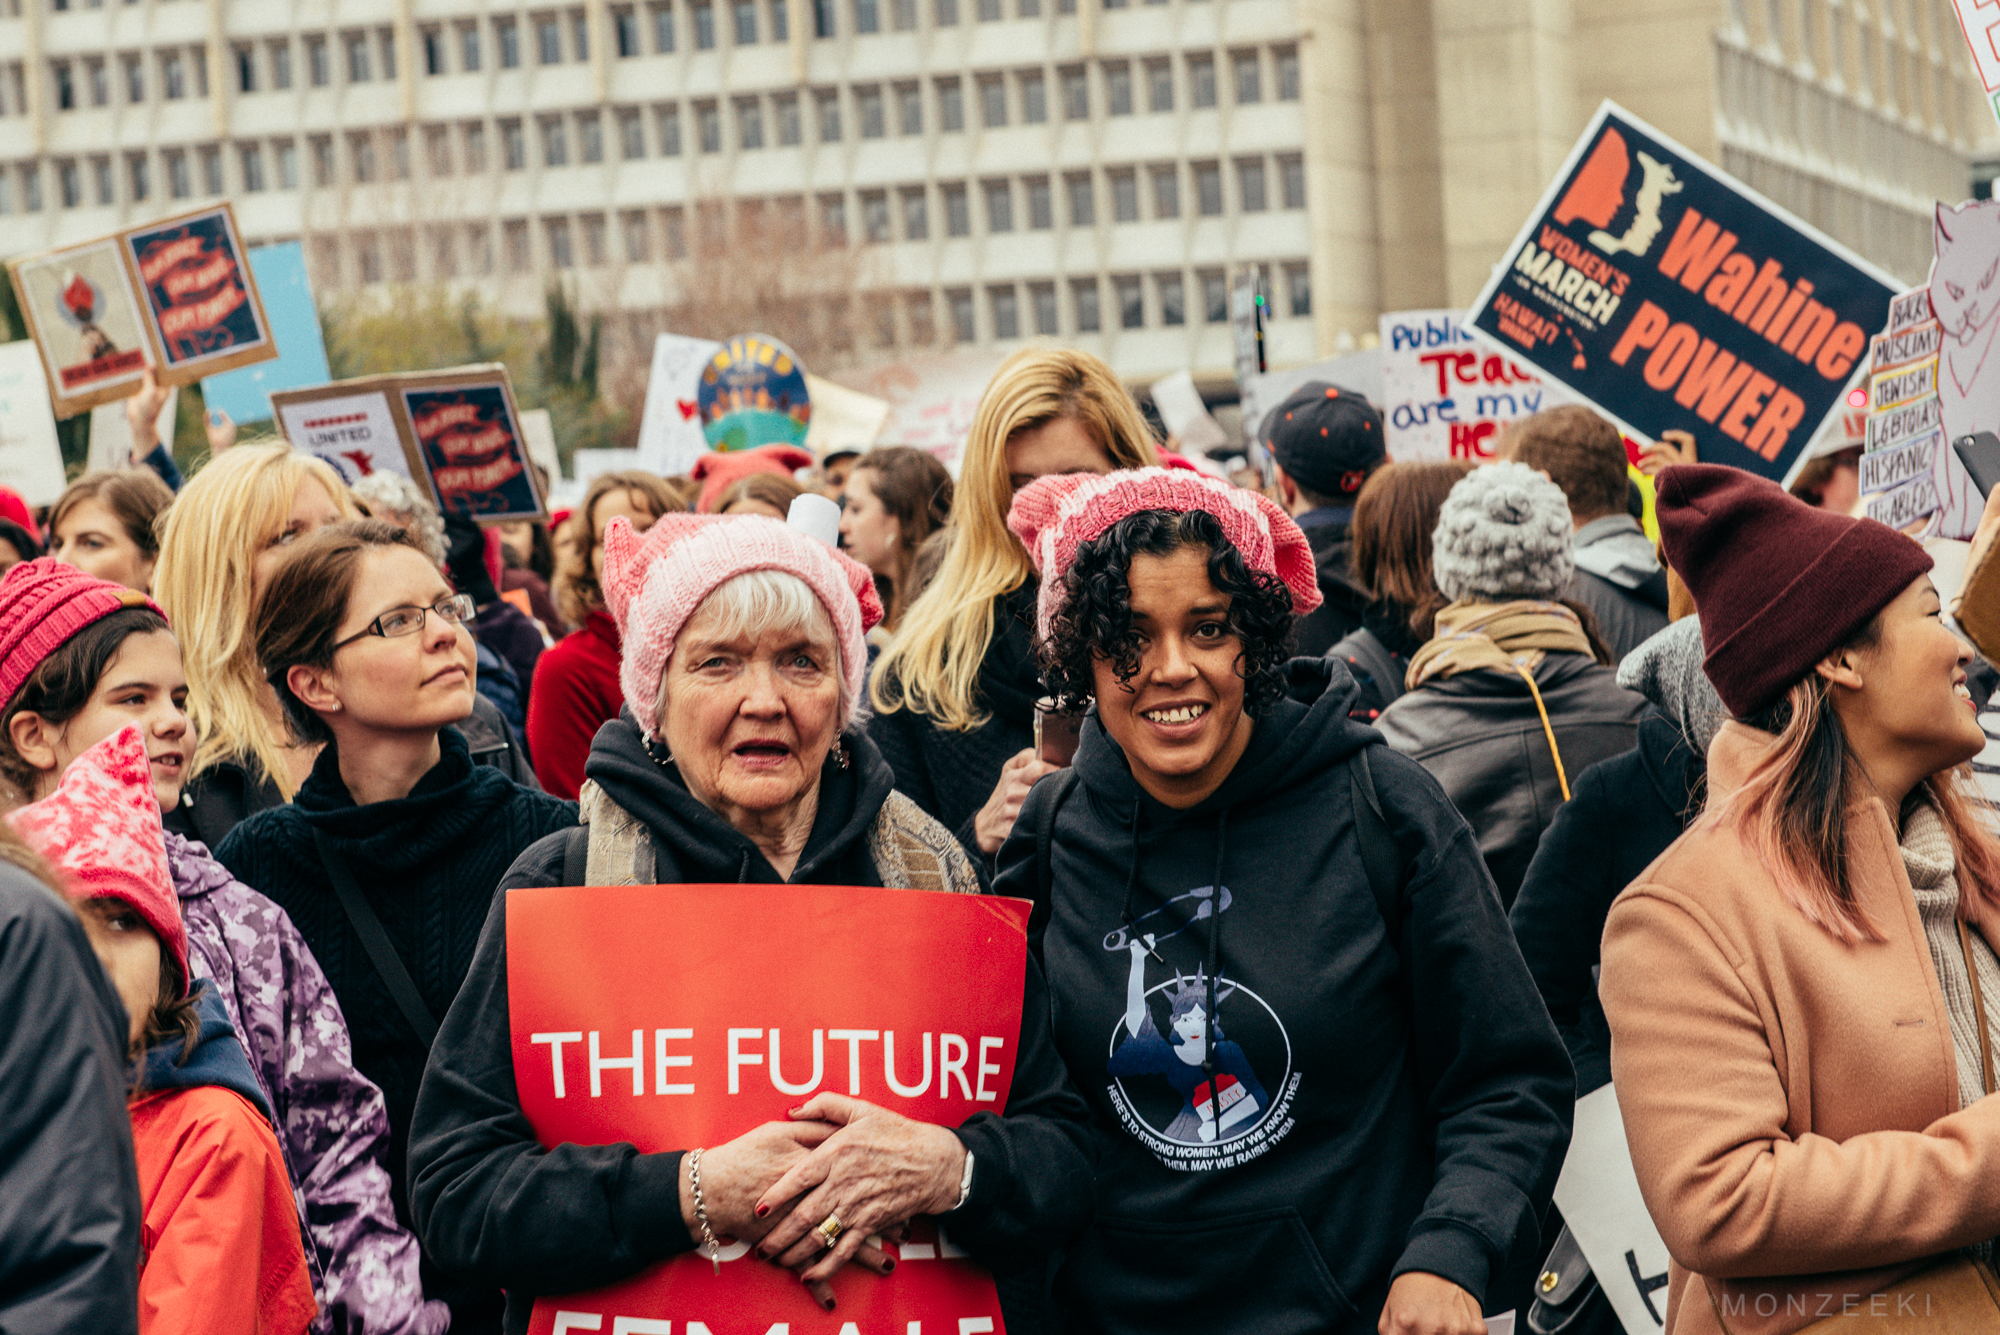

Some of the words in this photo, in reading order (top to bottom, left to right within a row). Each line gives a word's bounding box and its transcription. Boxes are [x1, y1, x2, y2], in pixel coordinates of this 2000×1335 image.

[1514, 241, 1621, 325] MARCH
[1539, 224, 1631, 296] WOMEN'S
[1657, 206, 1866, 381] Wahine
[1609, 300, 1806, 463] POWER
[1874, 326, 1938, 366] MUSLIM?
[1392, 397, 1460, 430] are
[531, 1028, 695, 1098] THE
[727, 1028, 1004, 1102] FUTURE
[1107, 1084, 1131, 1123] HERE'S
[1127, 1118, 1139, 1135] TO
[1138, 1130, 1175, 1156] STRONG
[1223, 1138, 1246, 1155] MAY
[1246, 1128, 1266, 1146] WE
[1264, 1100, 1290, 1134] KNOW
[1284, 1071, 1303, 1101] THEM
[1190, 1159, 1214, 1172] MAY
[1215, 1155, 1235, 1170] WE
[1236, 1141, 1270, 1165] RAISE
[1268, 1116, 1296, 1145] THEM
